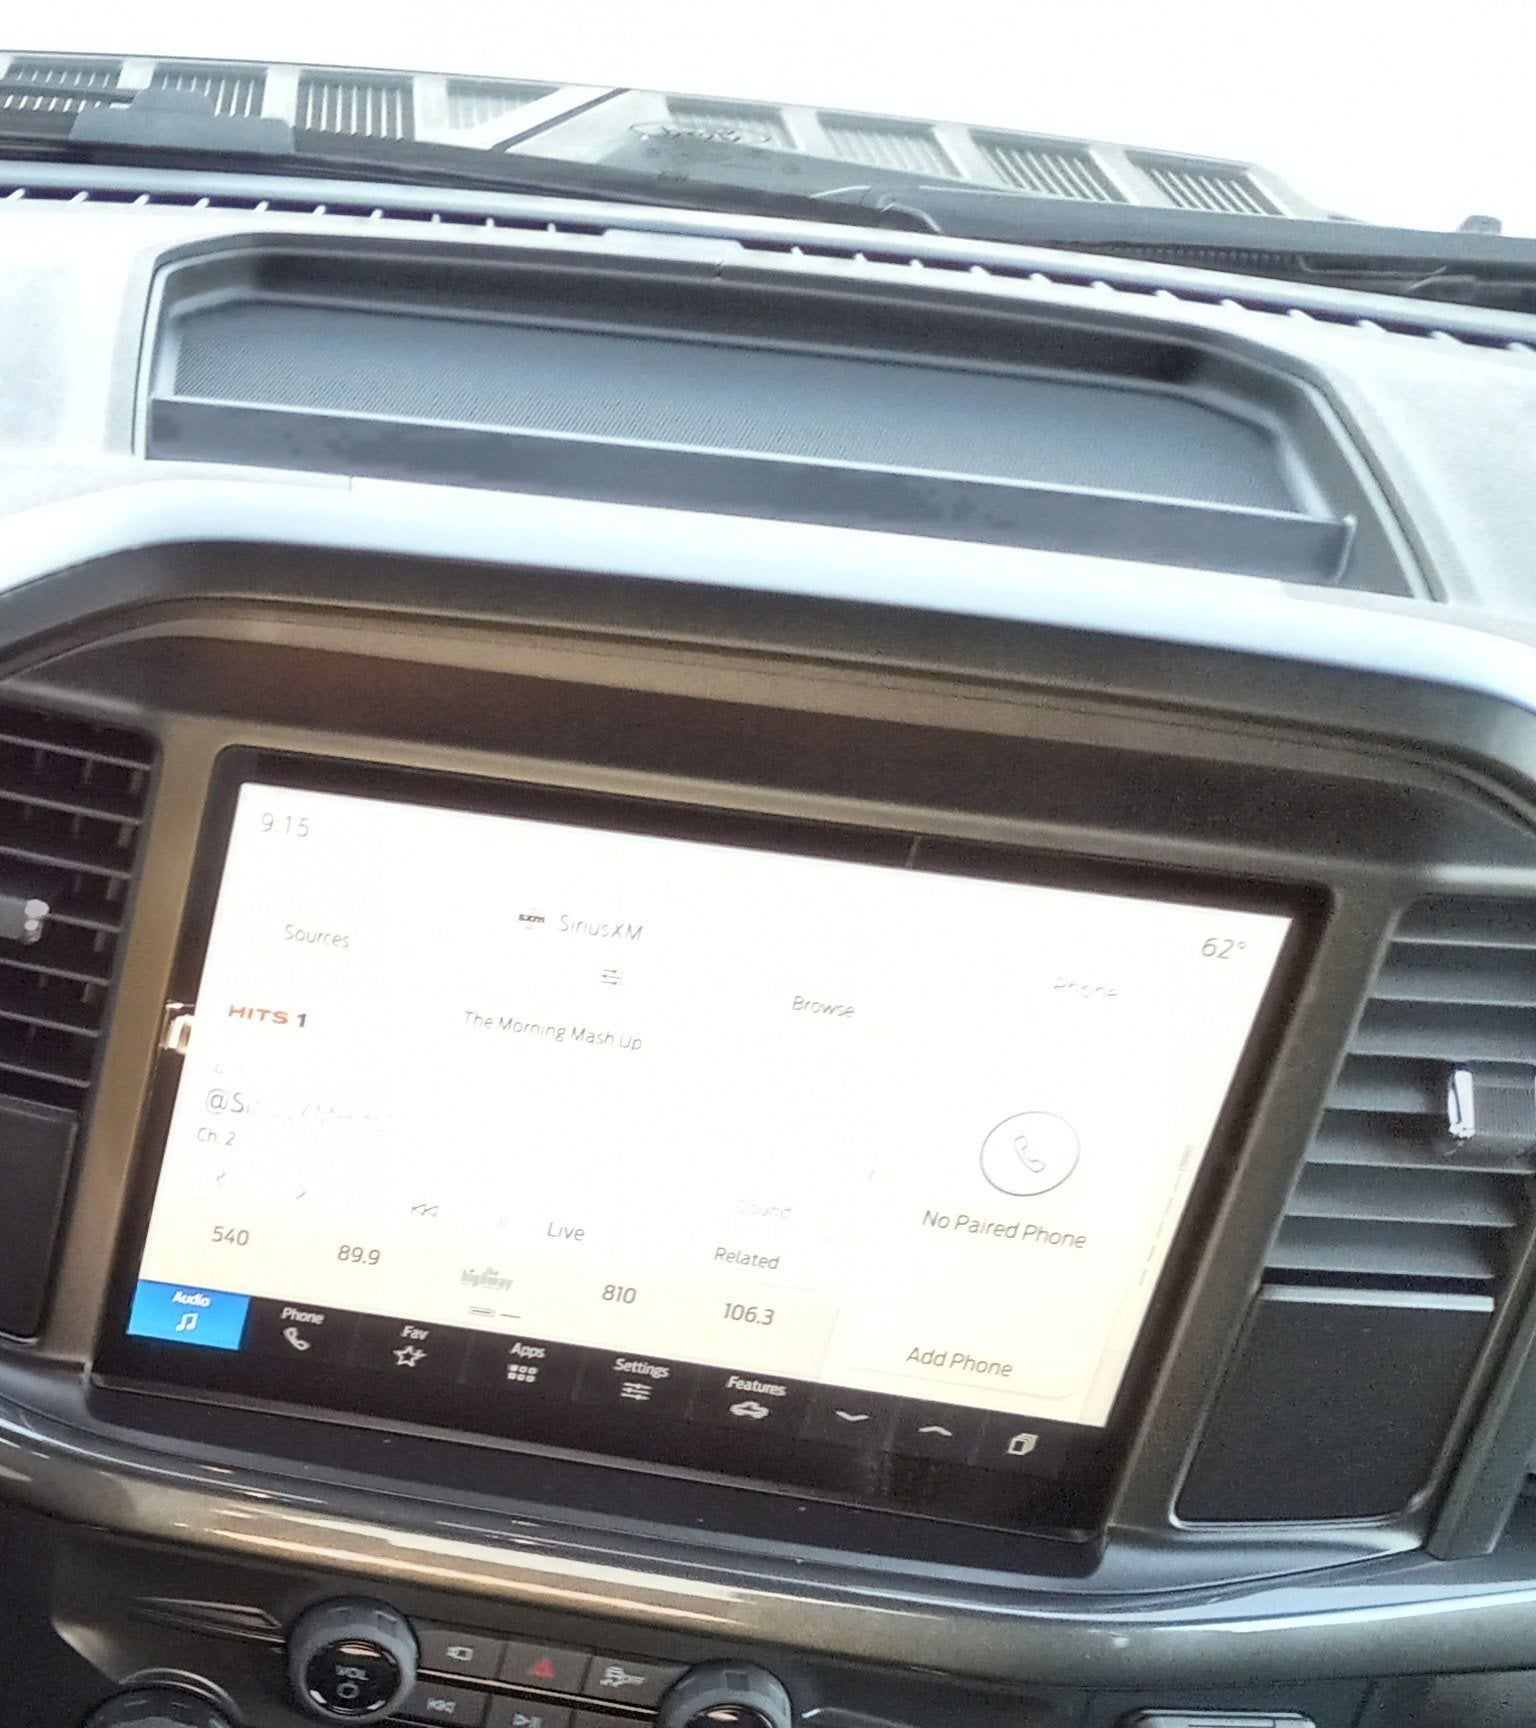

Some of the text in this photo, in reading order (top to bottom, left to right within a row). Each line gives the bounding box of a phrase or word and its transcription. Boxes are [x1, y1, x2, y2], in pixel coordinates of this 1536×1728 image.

[284, 923, 351, 949] Sources
[560, 914, 643, 942] SiriusXM
[228, 1004, 309, 1029] HITS 1
[792, 995, 856, 1019] Browse
[464, 1010, 644, 1052] The Morning Mash Up
[211, 1225, 249, 1247] 540
[547, 1221, 585, 1242] Live
[922, 1210, 1088, 1251] No Paired Phone
[337, 1244, 381, 1267] 89.9
[714, 1245, 781, 1271] Related
[172, 1291, 211, 1307] Audio
[601, 1284, 637, 1304] 810
[280, 1307, 325, 1325] Phone
[723, 1302, 775, 1326] 106.3
[400, 1325, 429, 1341] Fav
[510, 1342, 546, 1360] Apps
[906, 1346, 1014, 1379] Add Phone
[613, 1358, 670, 1379] Settings
[727, 1375, 787, 1397] Features
